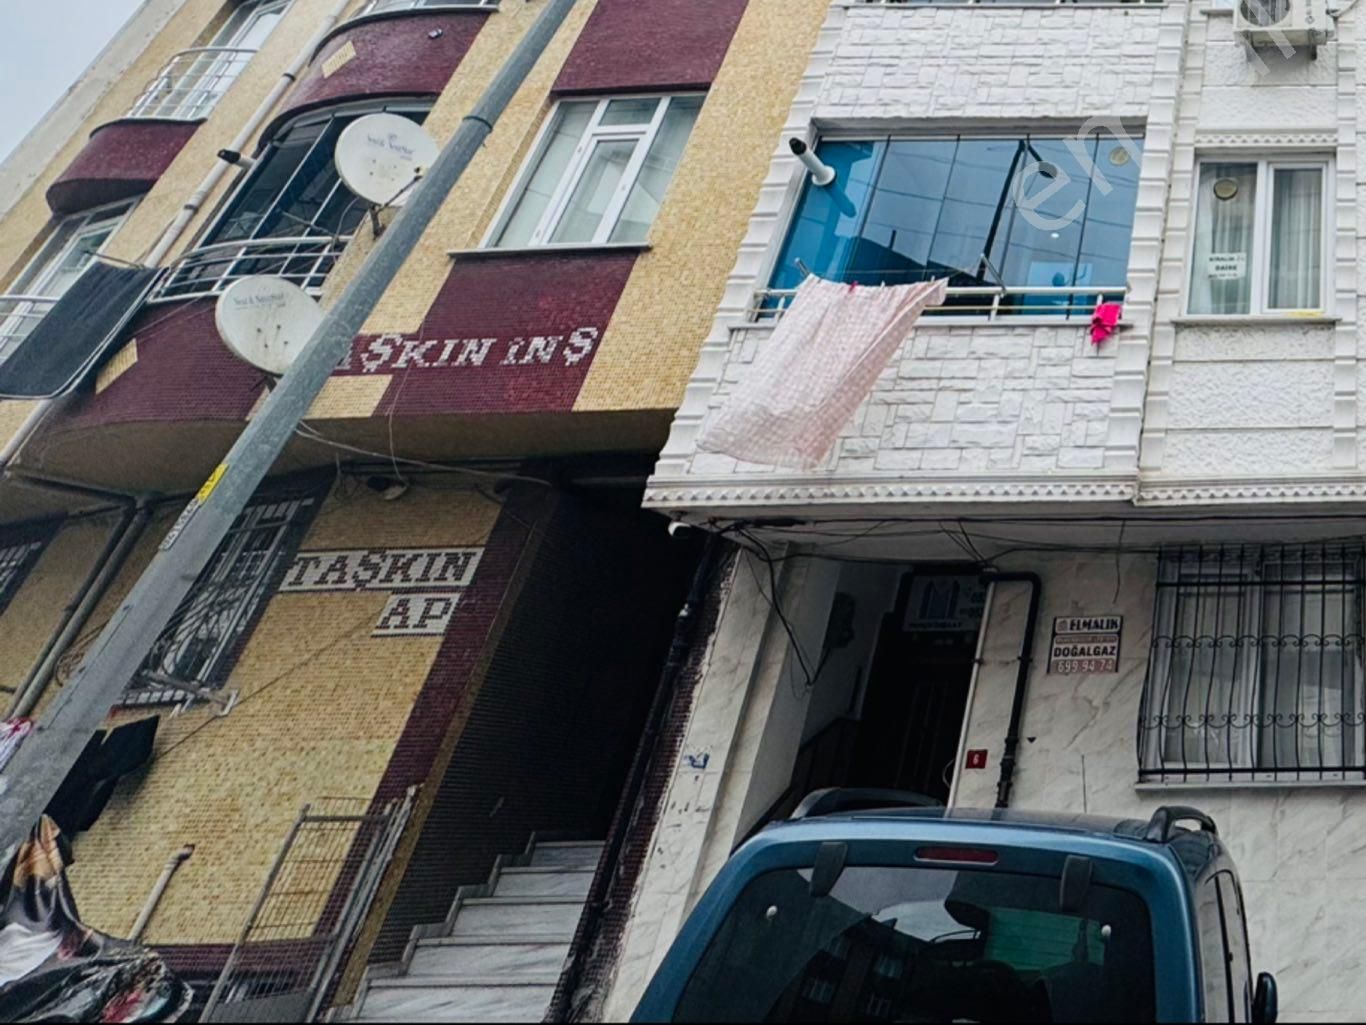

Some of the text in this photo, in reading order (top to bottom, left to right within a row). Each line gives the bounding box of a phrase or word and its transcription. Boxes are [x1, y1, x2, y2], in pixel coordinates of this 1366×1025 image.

[288, 549, 477, 589] TAŞKIN
[376, 597, 451, 630] AP
[1053, 644, 1116, 658] DOĞALGAZ
[972, 753, 980, 766] 6
